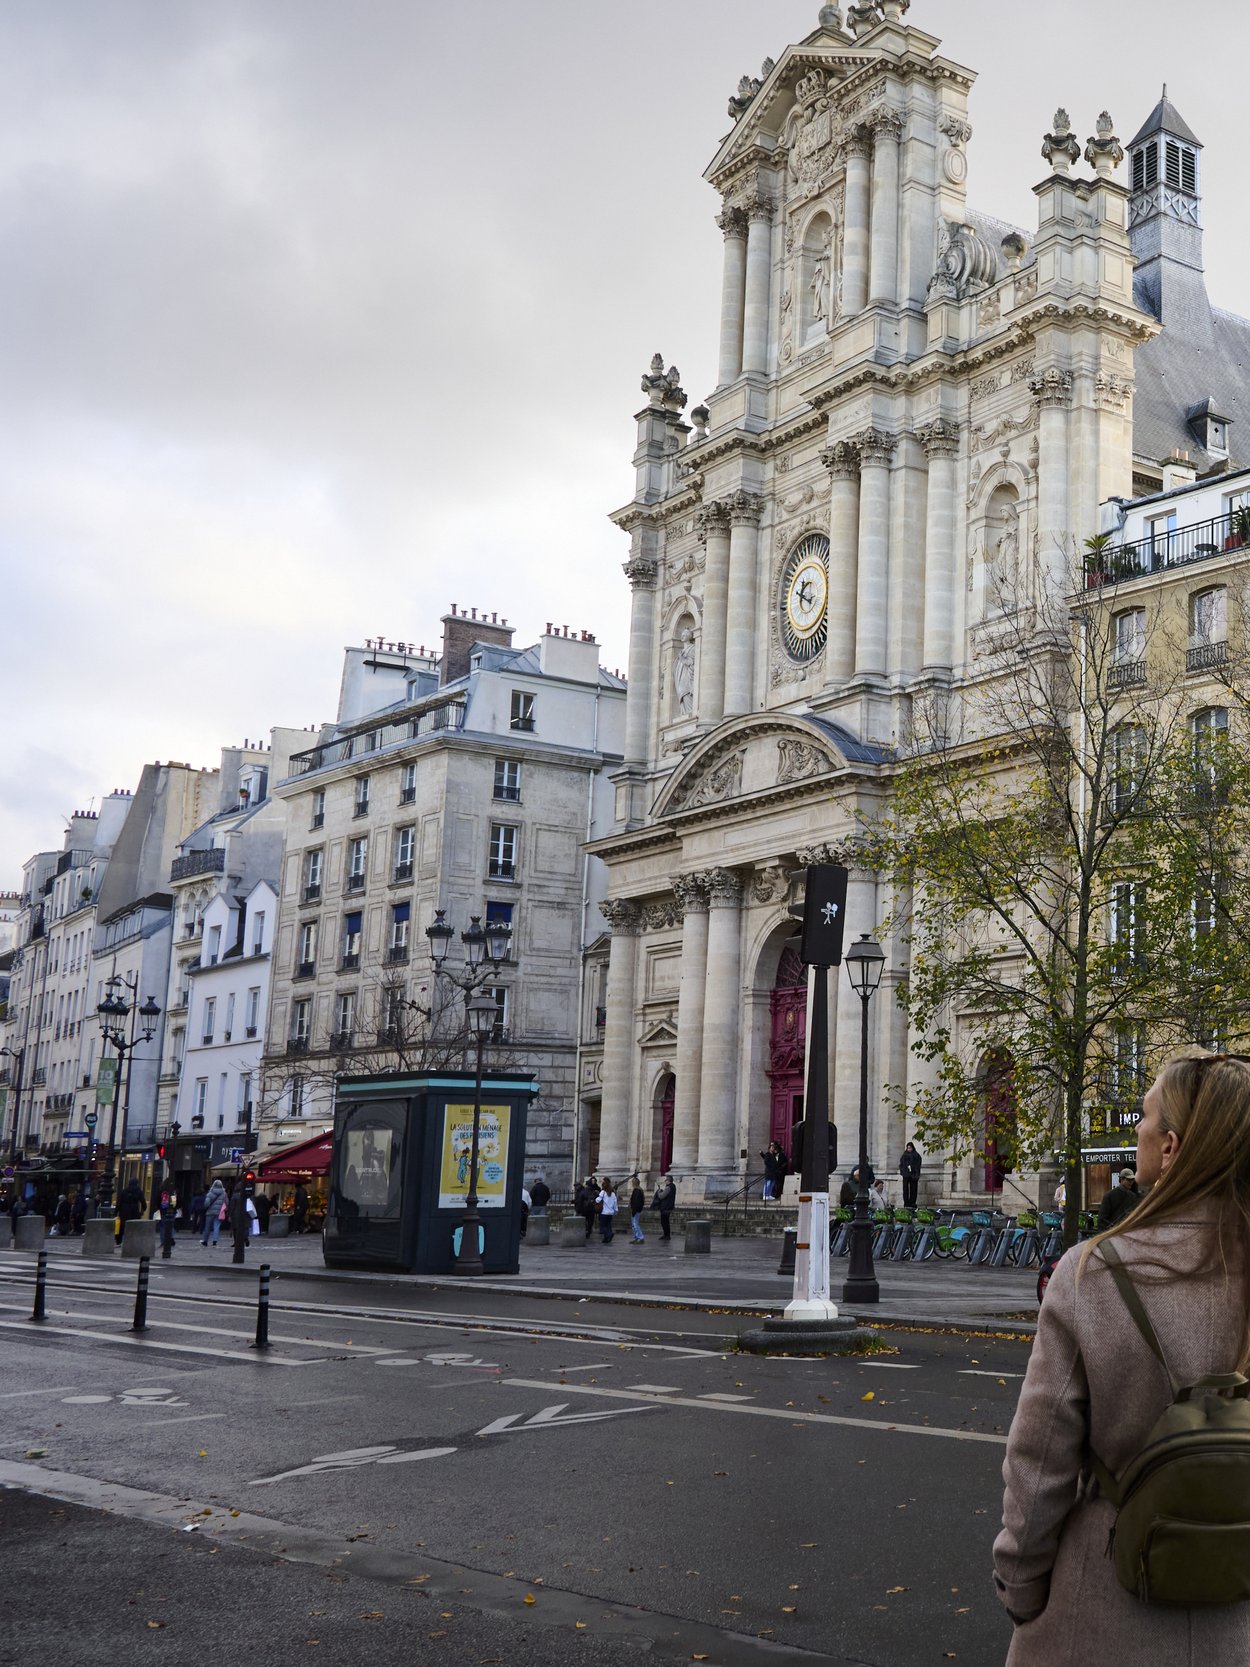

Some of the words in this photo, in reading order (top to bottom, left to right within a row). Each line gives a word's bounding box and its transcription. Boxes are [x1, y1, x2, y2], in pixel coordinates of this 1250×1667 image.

[457, 1123, 482, 1131] SOLUTN
[459, 1131, 469, 1139] DES
[1086, 1154, 1121, 1163] EMPORTER
